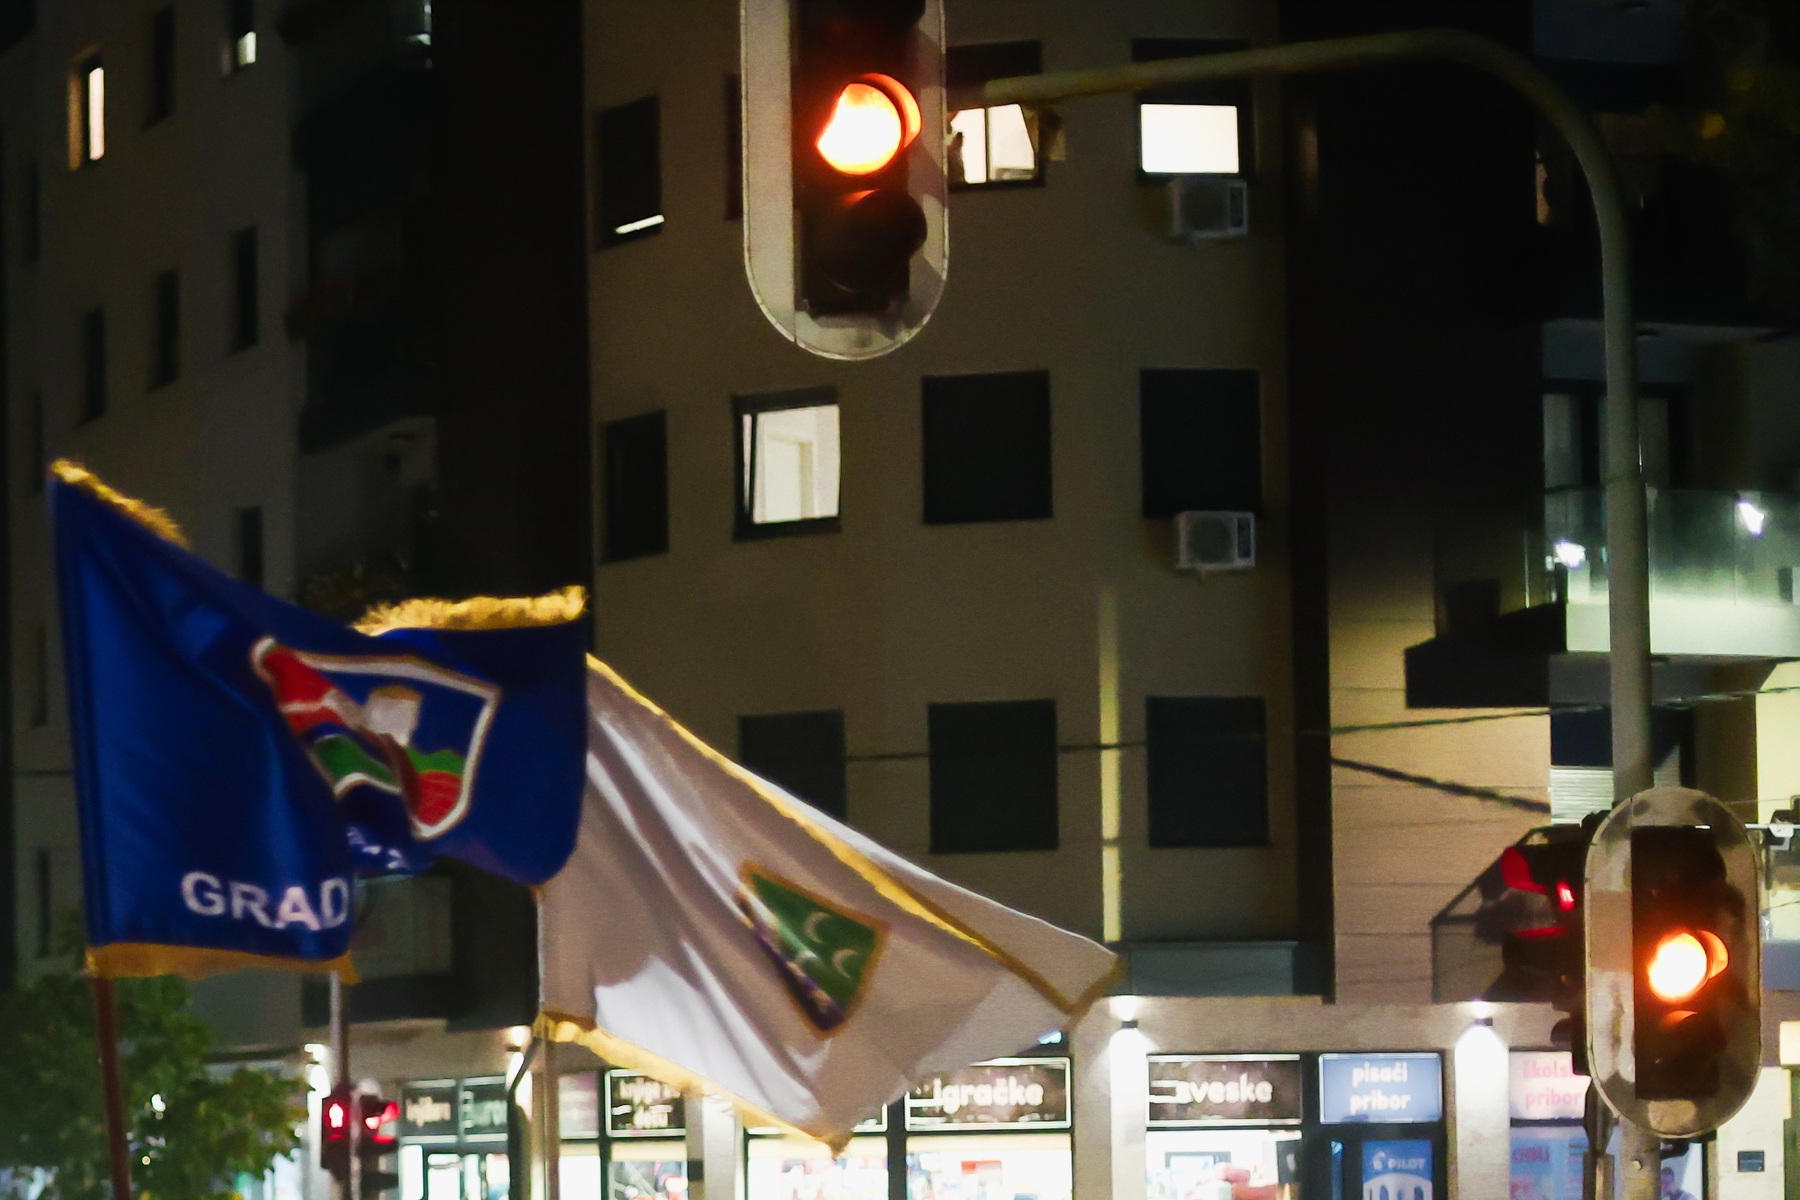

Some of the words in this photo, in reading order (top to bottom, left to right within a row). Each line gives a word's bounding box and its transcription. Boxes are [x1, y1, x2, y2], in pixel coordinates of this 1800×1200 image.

[181, 871, 349, 931] GRAD
[933, 1076, 1044, 1114] igračke
[1350, 1089, 1412, 1115] pribor
[1525, 1087, 1582, 1110] pribor
